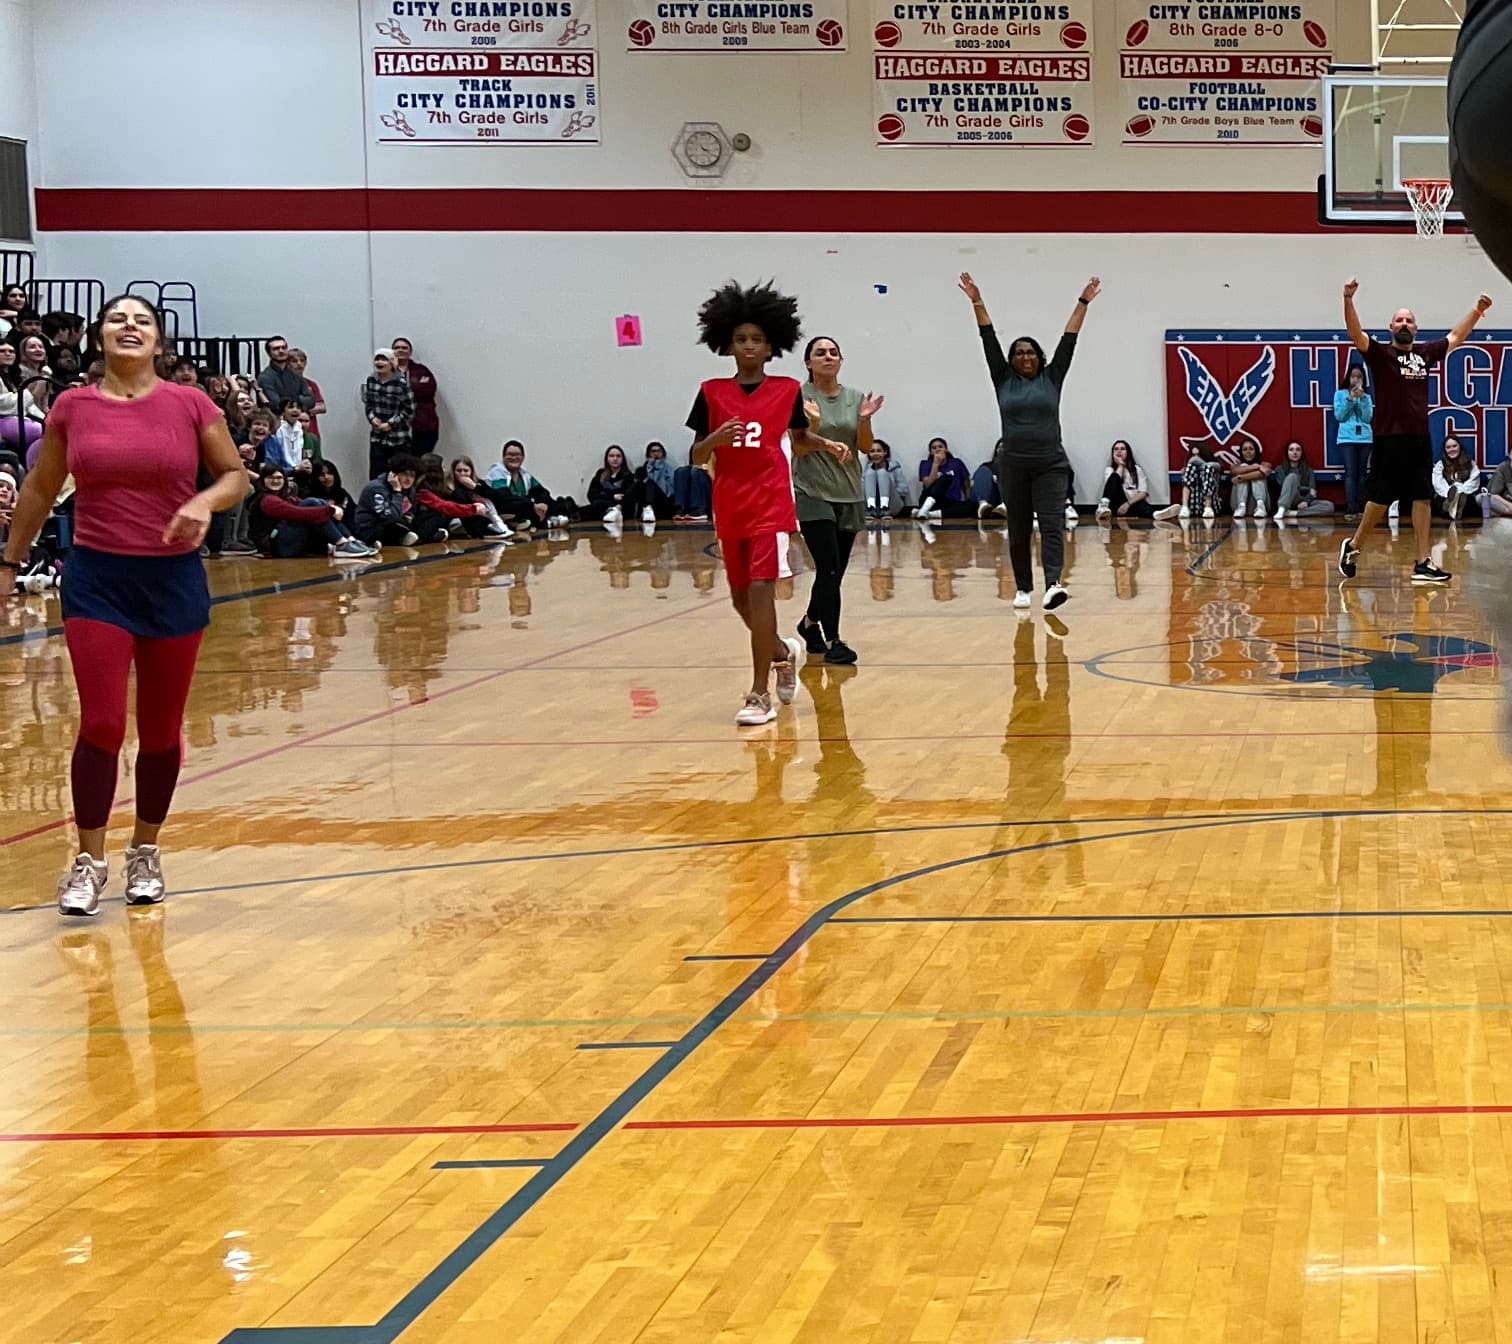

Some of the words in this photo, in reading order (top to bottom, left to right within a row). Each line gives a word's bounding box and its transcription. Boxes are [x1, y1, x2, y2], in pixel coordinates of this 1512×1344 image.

[393, 2, 439, 16] CITY
[451, 2, 571, 17] CHAMPIONS
[658, 4, 699, 18] CITY
[708, 4, 813, 18] CHAMPIONS
[894, 6, 939, 20] CITY
[951, 6, 1069, 20] CHAMPIONS
[1150, 5, 1189, 19] CITY
[1199, 6, 1301, 19] CHAMPIONS
[423, 19, 446, 32] 7th
[455, 19, 501, 32] Grade
[509, 19, 544, 32] Girls
[662, 22, 680, 34] 8th
[685, 22, 718, 34] Grade
[722, 22, 747, 34] Girls
[752, 22, 776, 34] Blue
[780, 22, 809, 34] Team
[922, 22, 946, 35] 7th
[953, 23, 999, 35] Grade
[1007, 23, 1041, 35] Girls
[1169, 24, 1194, 36] 8th
[1202, 24, 1247, 36] Grade
[1254, 24, 1283, 36] 8-0
[378, 55, 489, 74] HAGGARD
[500, 56, 592, 75] EAGLES
[878, 58, 987, 78] HAGGARD
[998, 60, 1088, 80] EAGLES
[1124, 57, 1231, 76] HAGGARD
[1242, 58, 1329, 75] EAGLES
[459, 80, 512, 91] TRACK
[929, 83, 1038, 95] BASKETBALL
[1189, 83, 1265, 94] FOOTBALL
[397, 94, 443, 108] CITY
[455, 95, 575, 108] CHAMPIONS
[586, 84, 595, 106] 2011
[897, 98, 942, 112] CITY
[954, 98, 1072, 112] CHAMPIONS
[1138, 97, 1208, 111] CO-CITY
[1216, 98, 1316, 111] CHAMPIONS
[427, 111, 451, 124] 7th
[459, 112, 505, 124] Grade
[513, 112, 548, 125] Girls
[924, 115, 948, 127] 7th
[956, 116, 1001, 127] Grade
[1009, 116, 1044, 127] Girls
[1161, 116, 1177, 124] 7th
[1181, 116, 1210, 125] Grade
[1214, 117, 1239, 125] Boys
[1243, 117, 1264, 125] Blue
[1268, 117, 1294, 125] Team
[478, 128, 499, 137] 2011
[1179, 346, 1275, 445] EAGLES
[732, 422, 762, 448] 2
